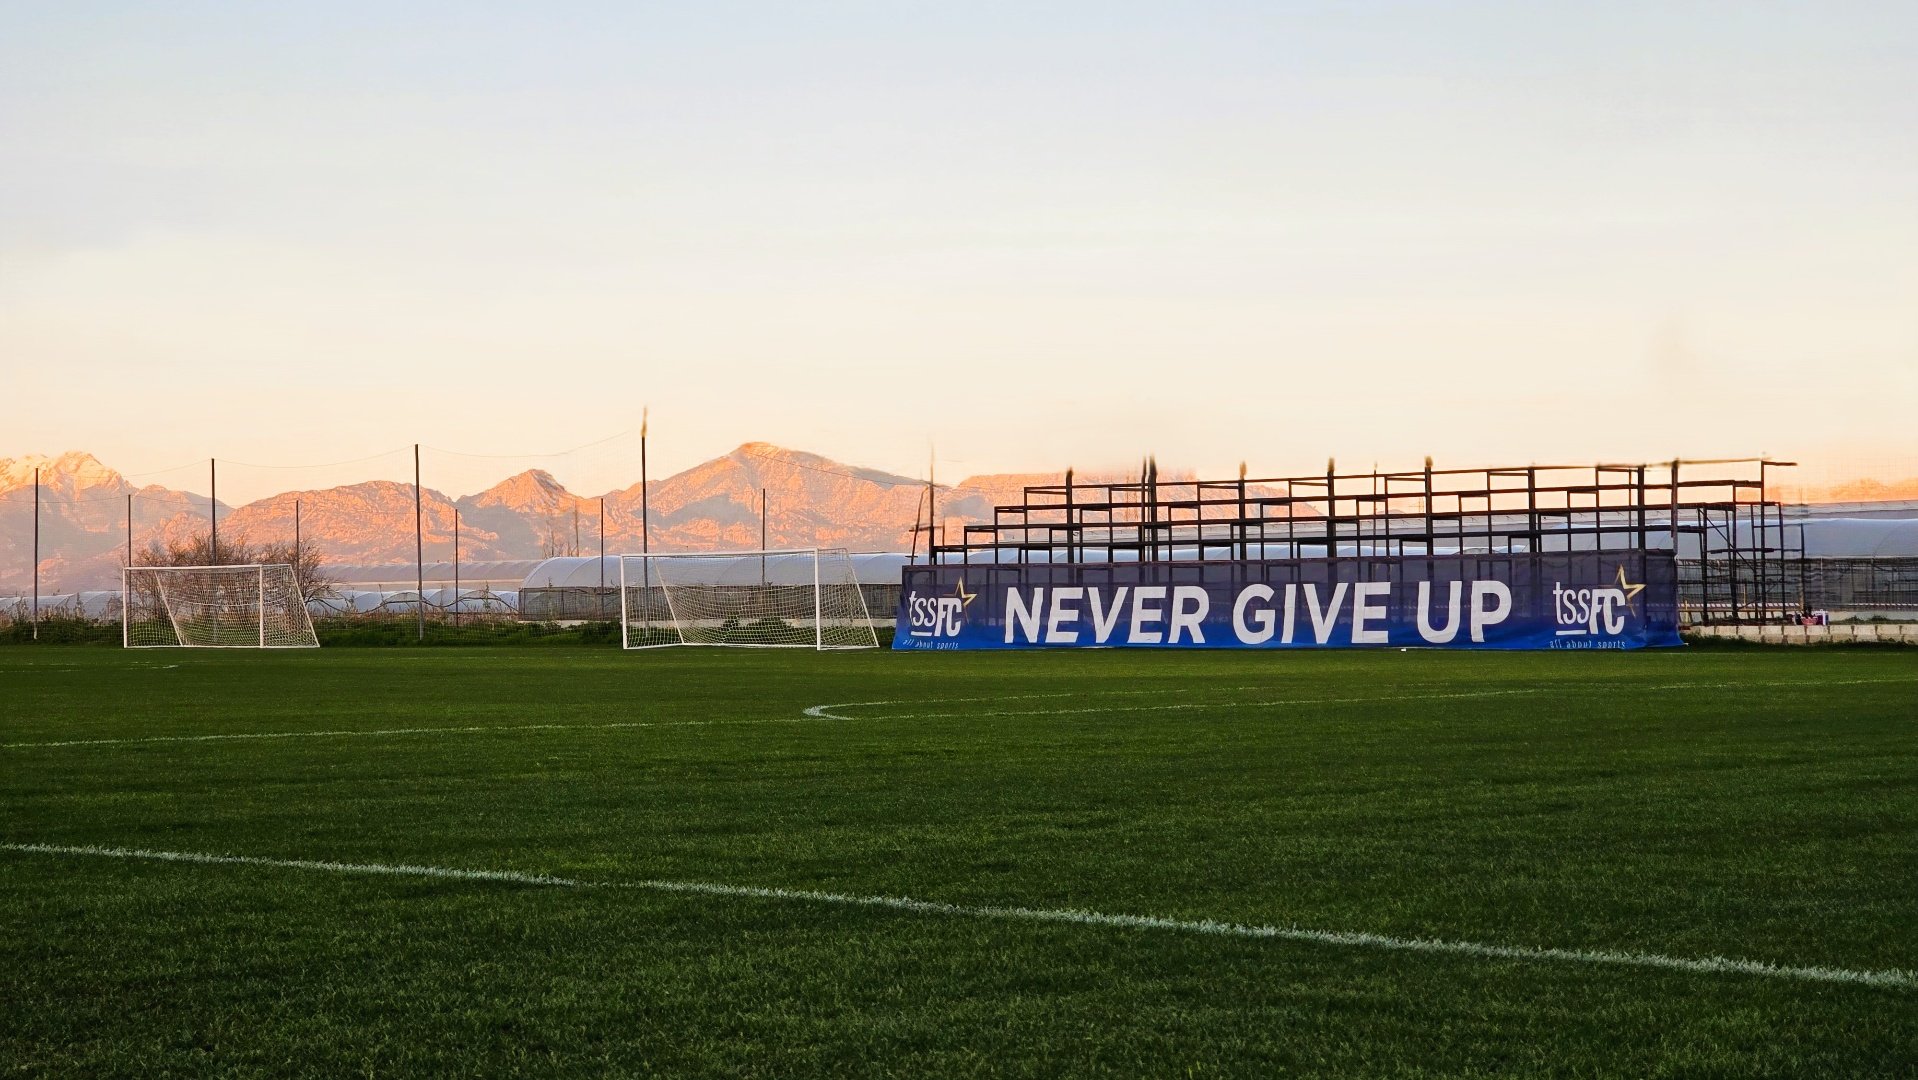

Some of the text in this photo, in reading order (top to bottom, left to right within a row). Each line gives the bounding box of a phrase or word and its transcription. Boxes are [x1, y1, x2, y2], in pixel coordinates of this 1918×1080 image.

[1004, 580, 1512, 645] NEVER GIVE UP
[915, 640, 934, 649] about
[937, 641, 959, 649] sports
[1549, 639, 1626, 649] all about sports
